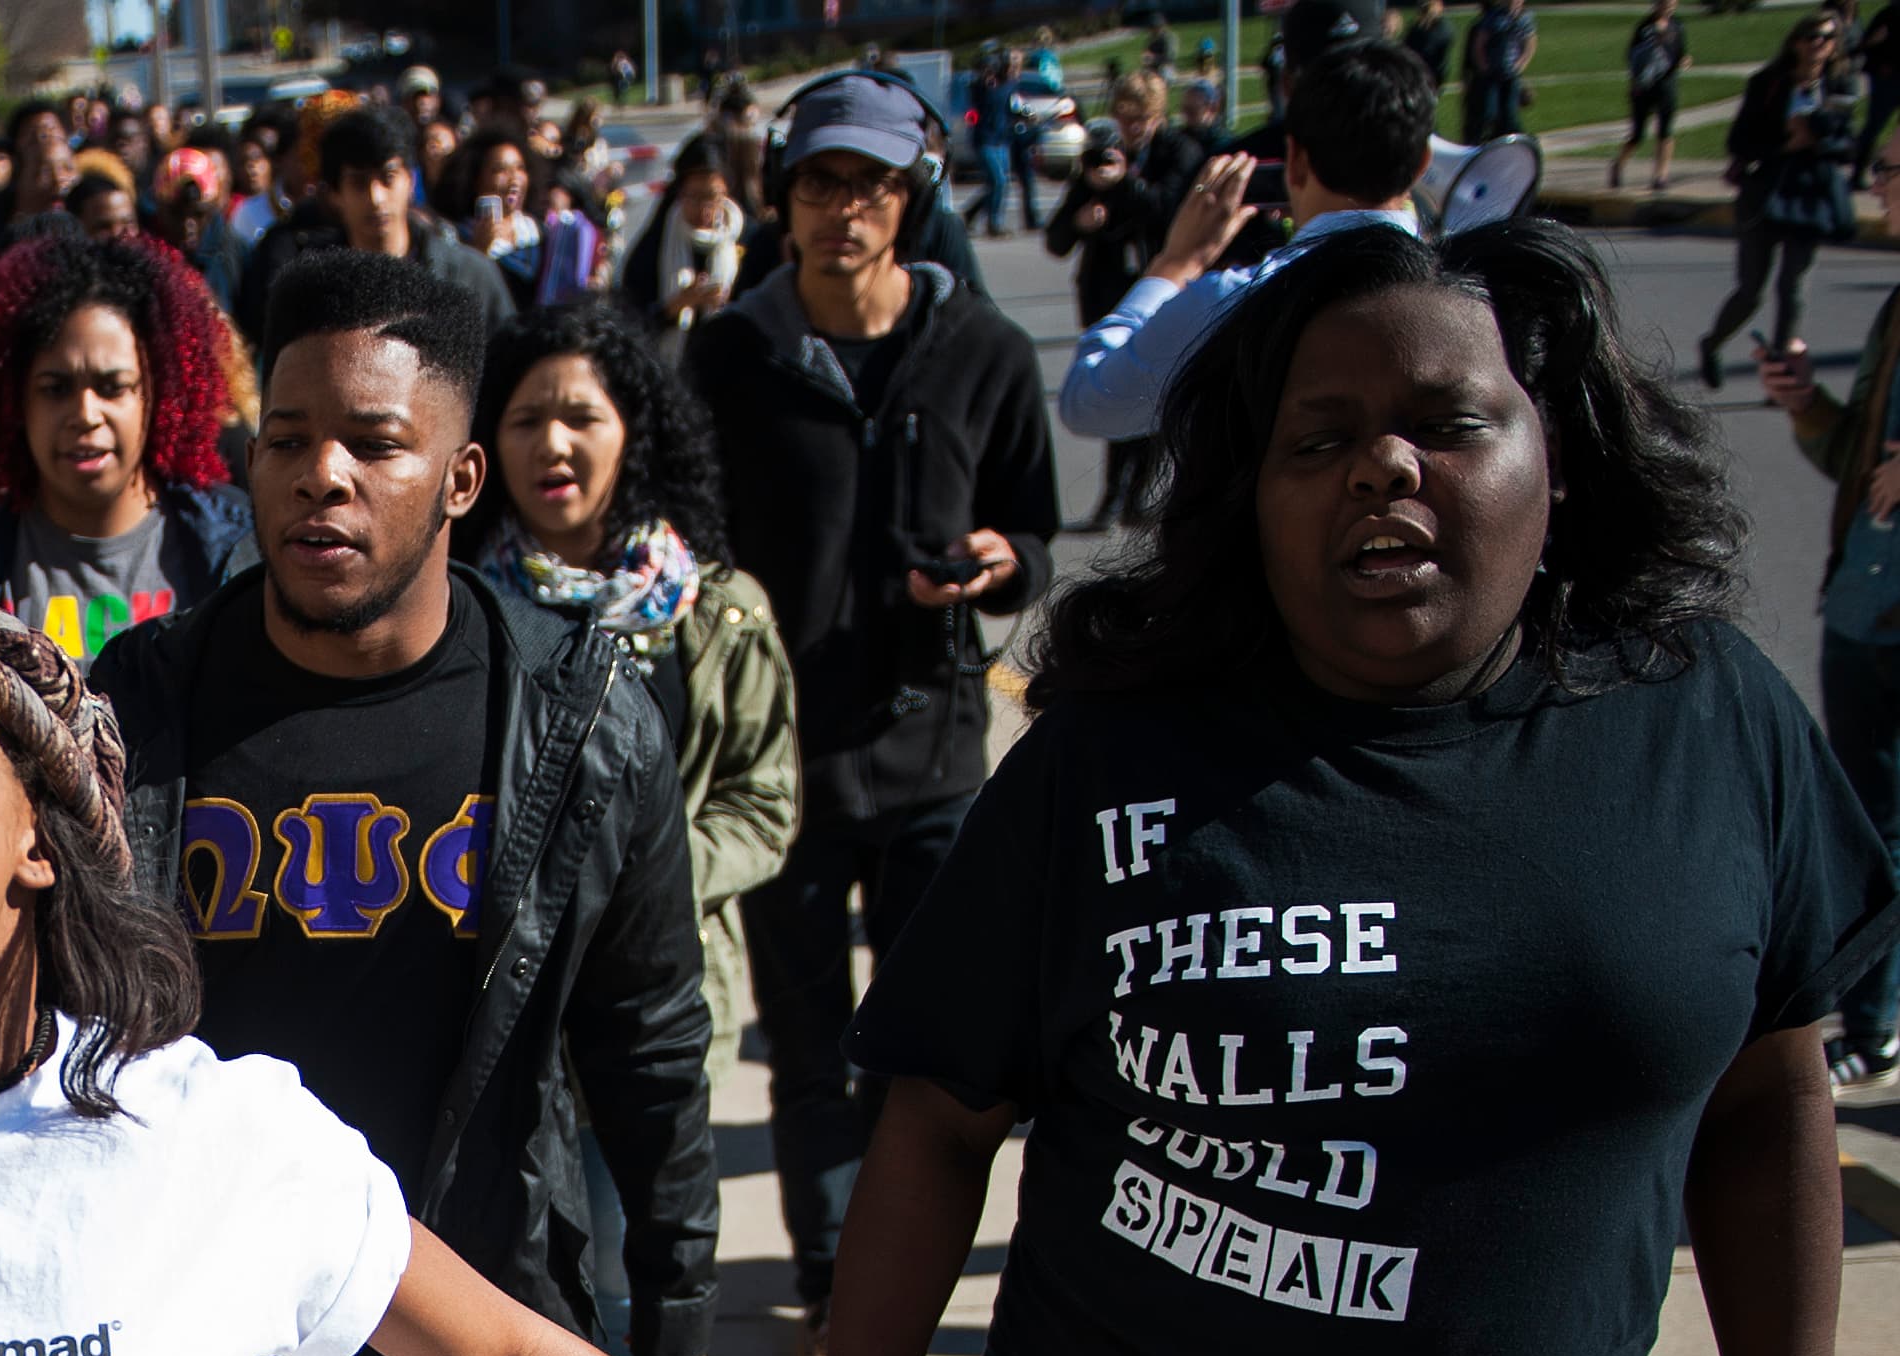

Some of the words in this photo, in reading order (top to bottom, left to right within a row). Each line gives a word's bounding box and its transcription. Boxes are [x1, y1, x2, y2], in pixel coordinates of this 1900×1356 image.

[1096, 798, 1175, 883] IF
[1106, 903, 1397, 998] THESE
[1109, 1010, 1408, 1105] WALLS
[1115, 1175, 1407, 1312] SPEAK
